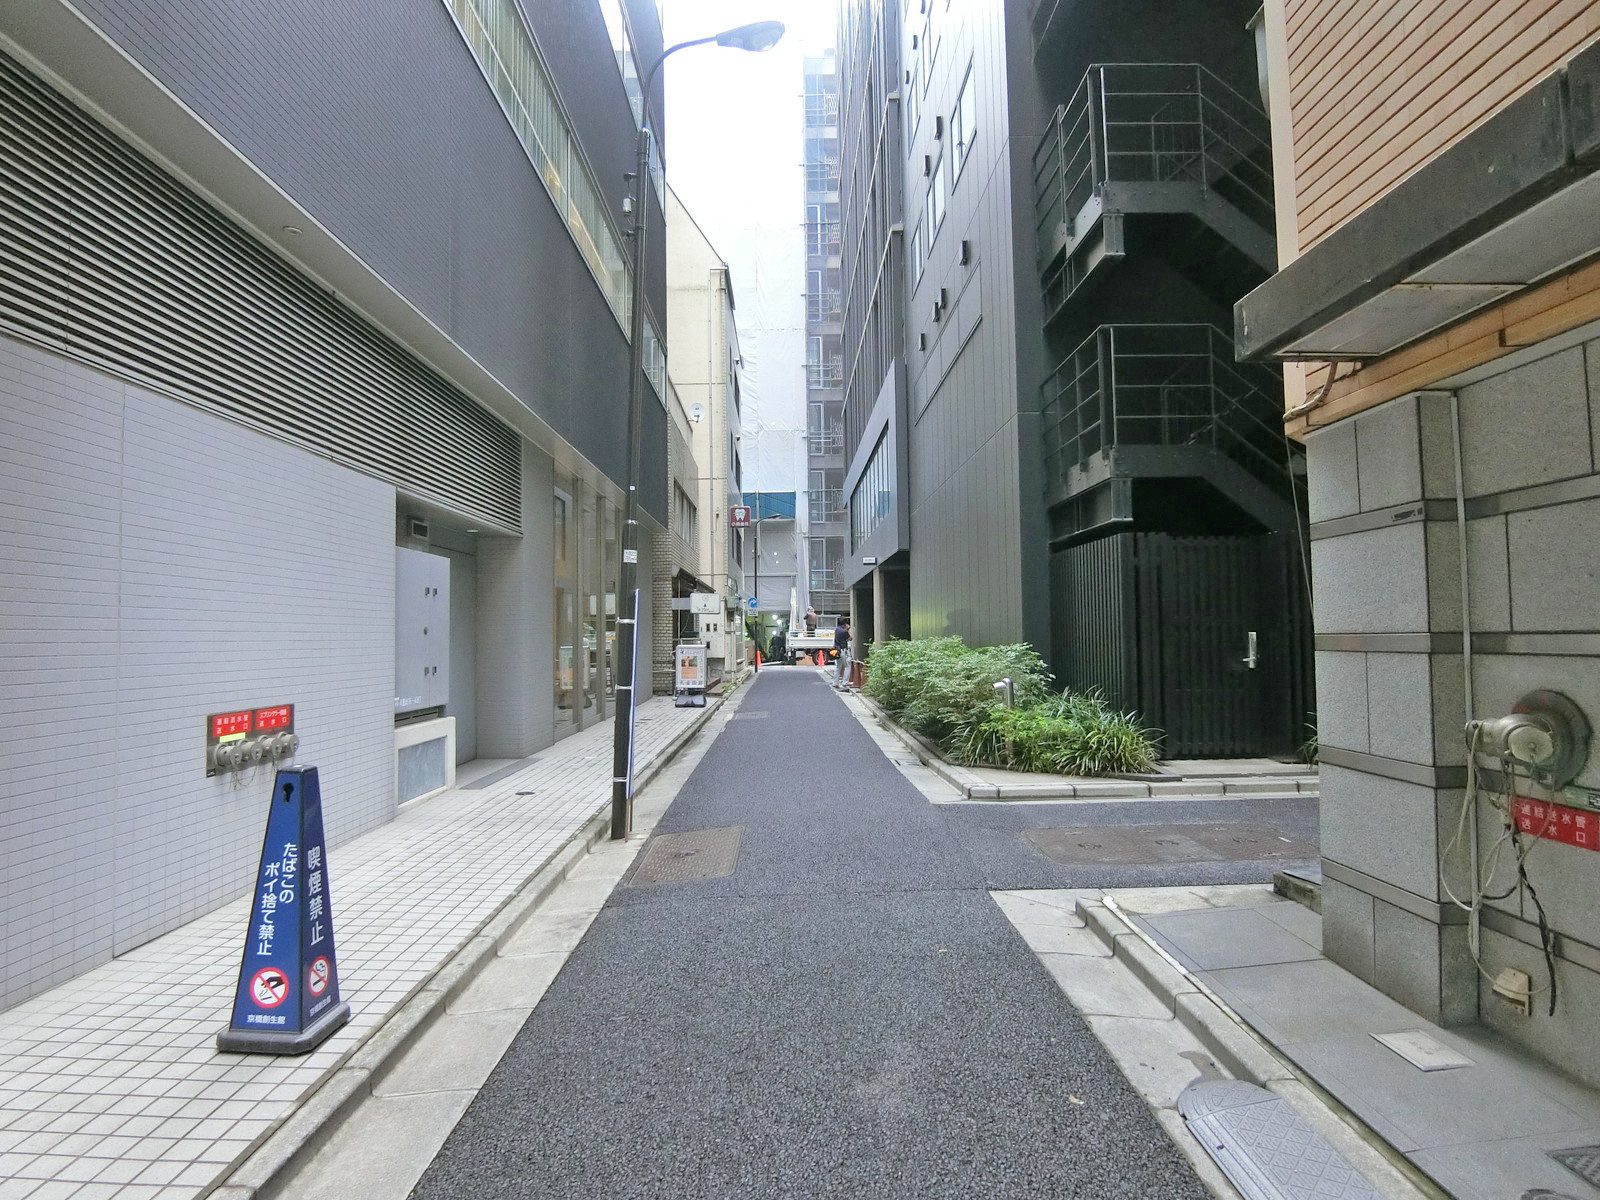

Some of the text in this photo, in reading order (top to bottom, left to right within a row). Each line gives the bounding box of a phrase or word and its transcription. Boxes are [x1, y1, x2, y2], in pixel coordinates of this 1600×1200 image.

[217, 723, 248, 735] 送水口
[1521, 803, 1586, 829] 連結送水管
[1521, 818, 1586, 843] 送水口
[280, 842, 298, 904] たばこの
[257, 862, 280, 955] ポイ捨て禁止
[307, 846, 324, 946] 喫煙禁止
